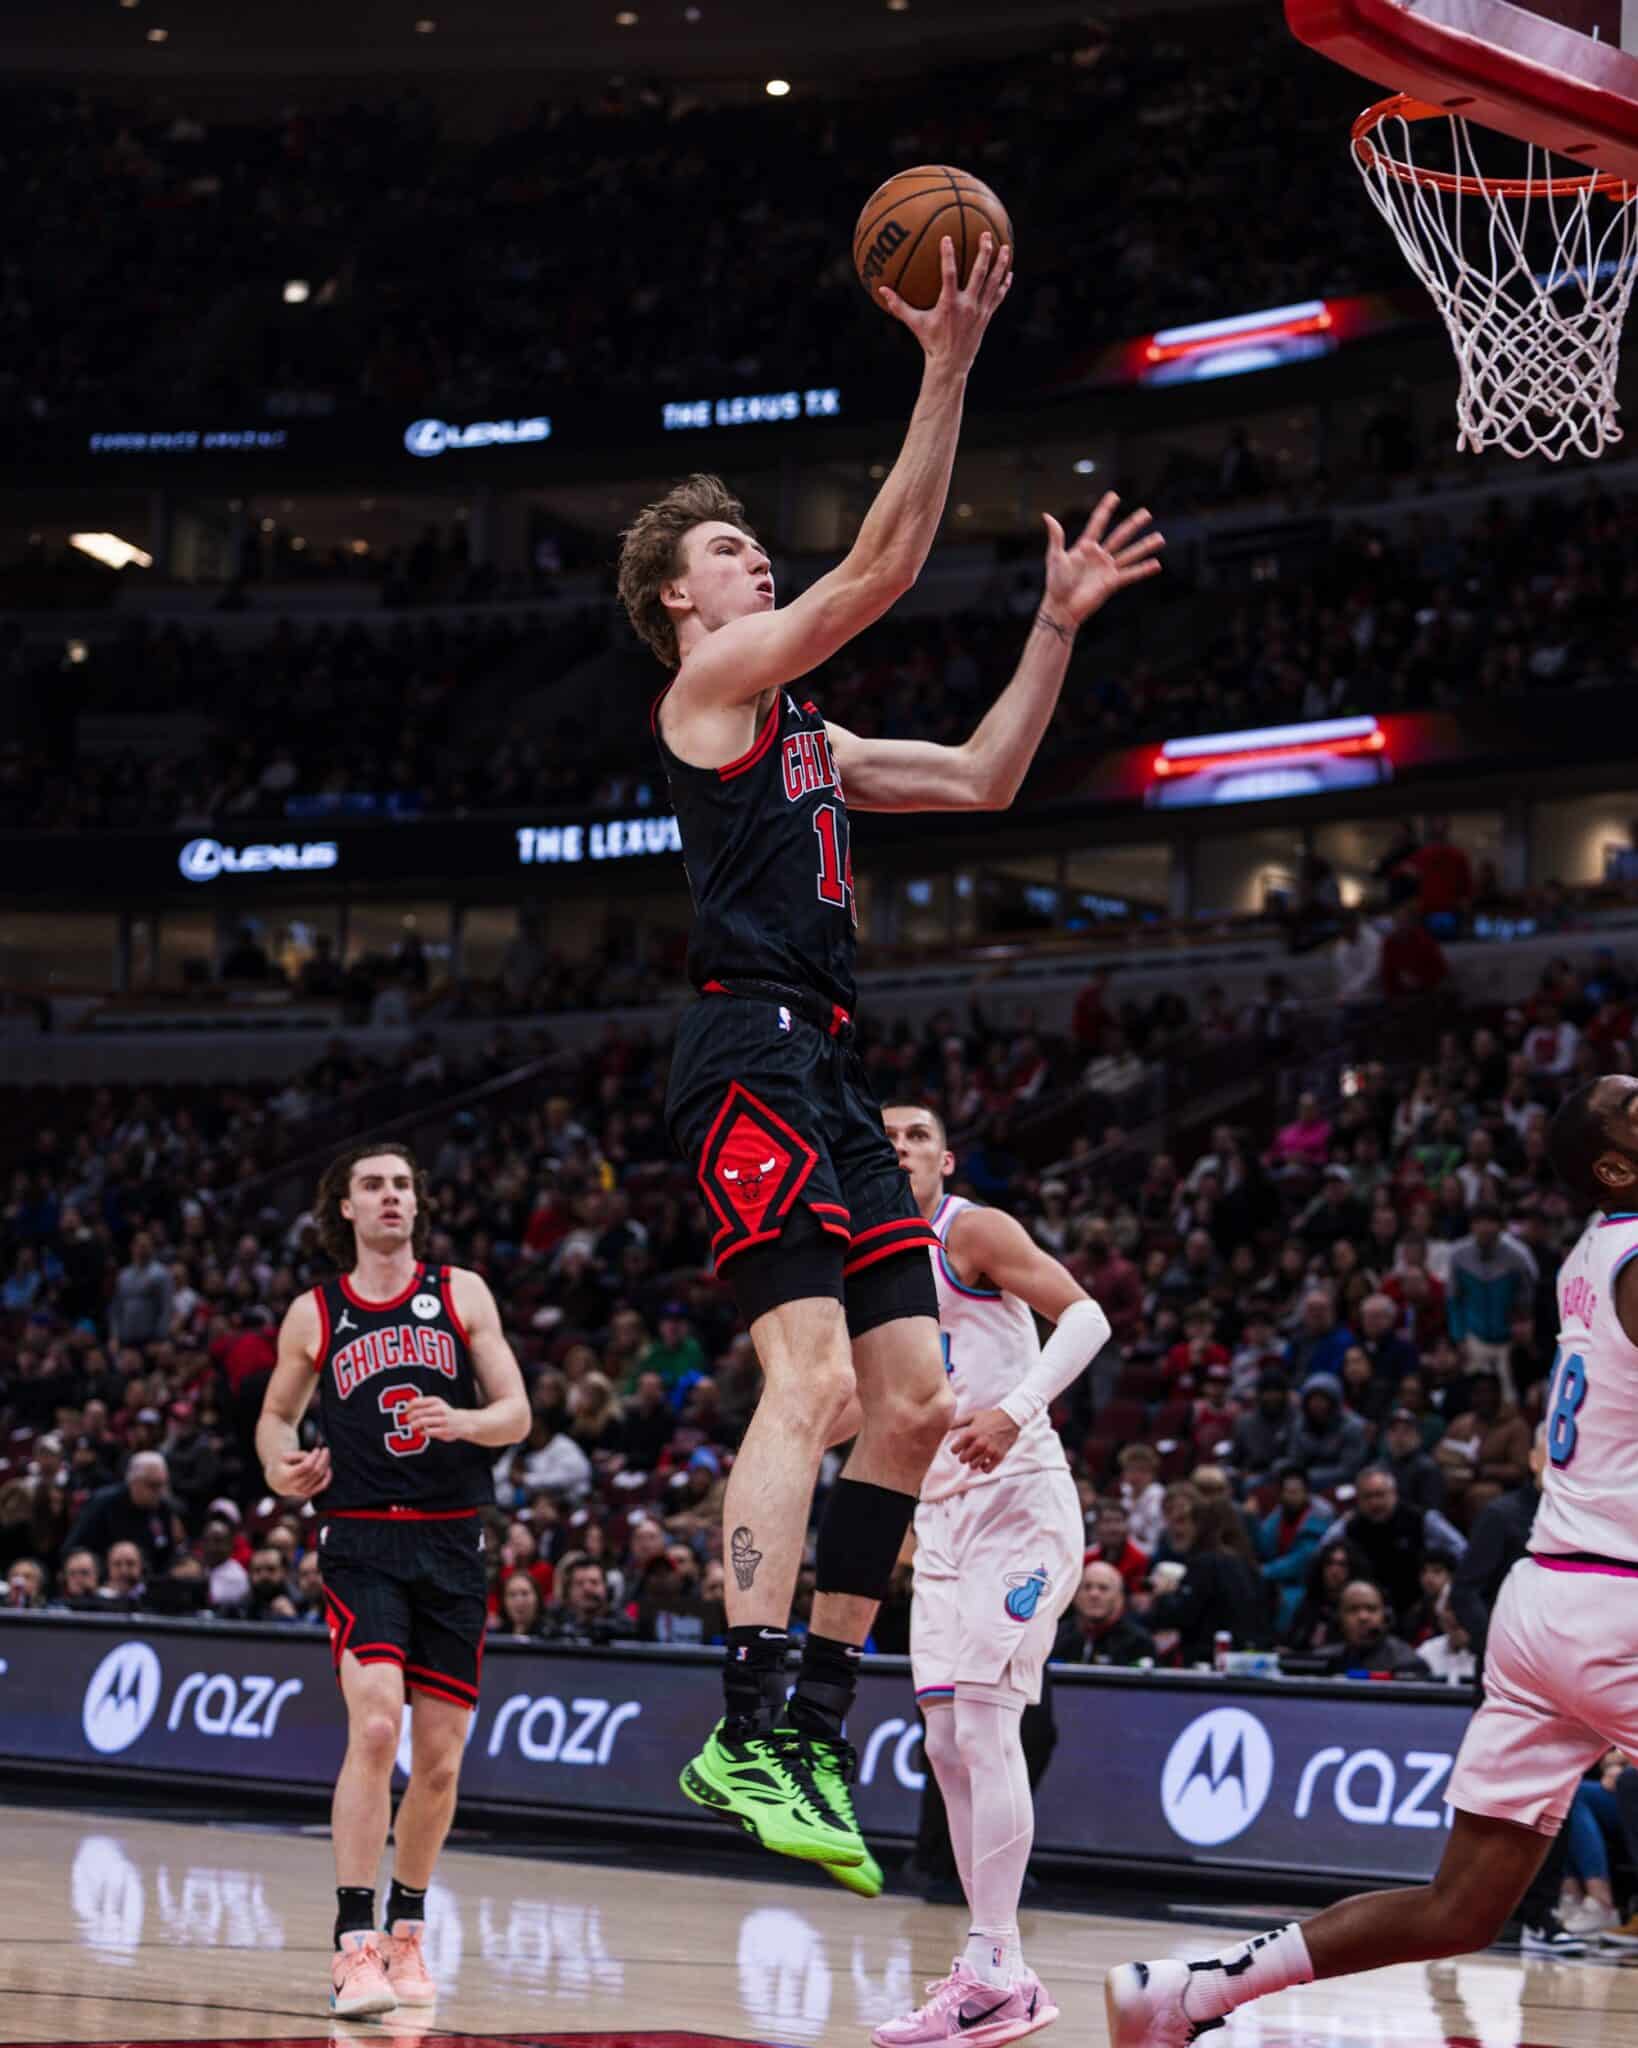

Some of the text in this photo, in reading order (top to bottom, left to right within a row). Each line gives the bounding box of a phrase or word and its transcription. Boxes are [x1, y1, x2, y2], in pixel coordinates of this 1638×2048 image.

[516, 825, 585, 864] THE
[813, 803, 858, 928] 1
[332, 1324, 458, 1401] CHICAGO
[377, 1383, 431, 1457] 3
[167, 1671, 303, 1739] razr
[487, 1693, 642, 1765] razr
